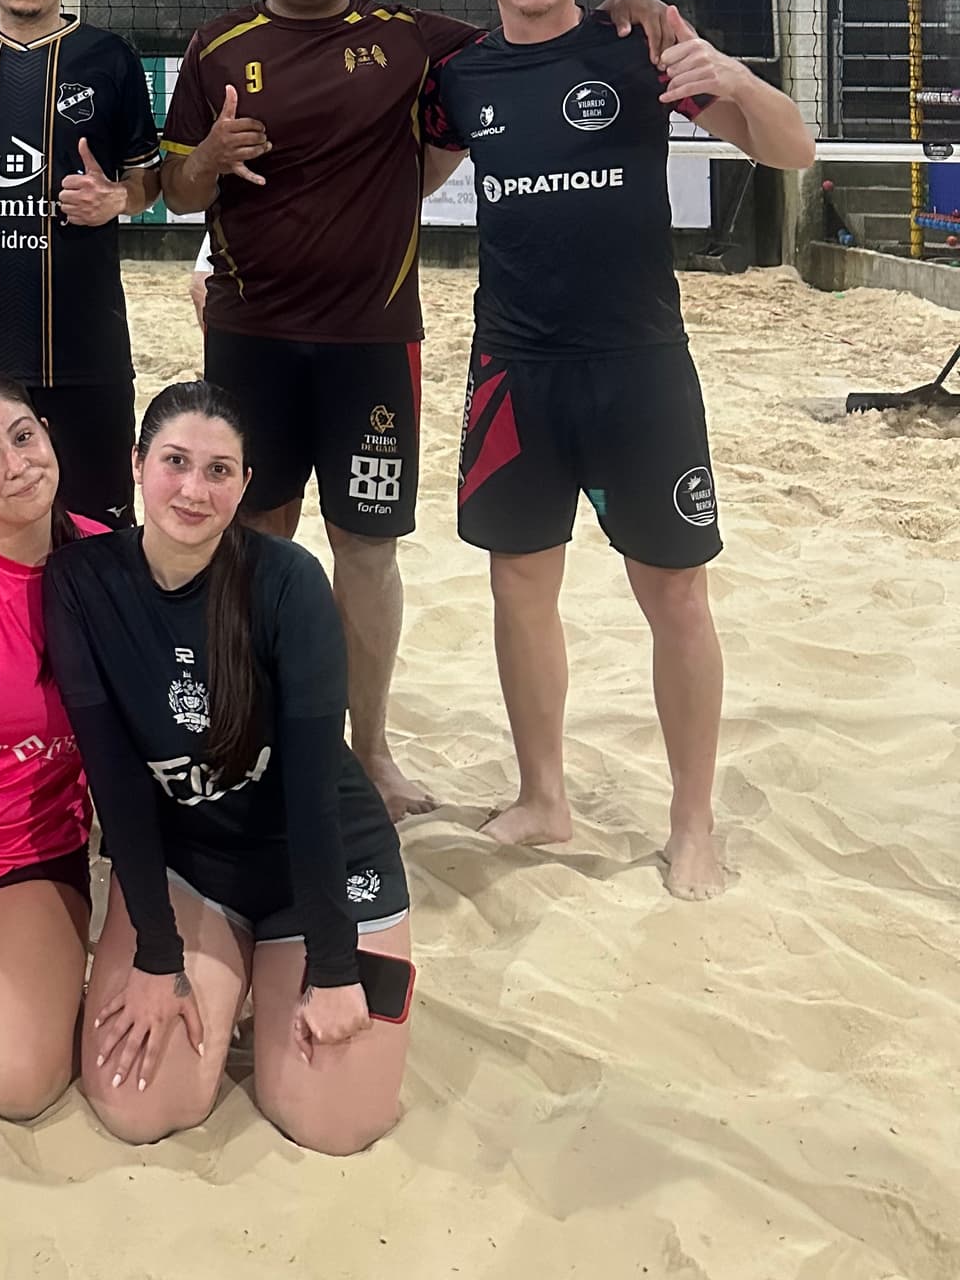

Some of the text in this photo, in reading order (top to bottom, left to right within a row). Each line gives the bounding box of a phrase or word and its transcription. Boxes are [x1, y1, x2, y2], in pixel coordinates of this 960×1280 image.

[245, 61, 264, 94] 9
[503, 167, 624, 197] PRATIQUE
[363, 434, 397, 446] TRIBO
[348, 454, 403, 501] 88
[357, 501, 392, 515] forfan
